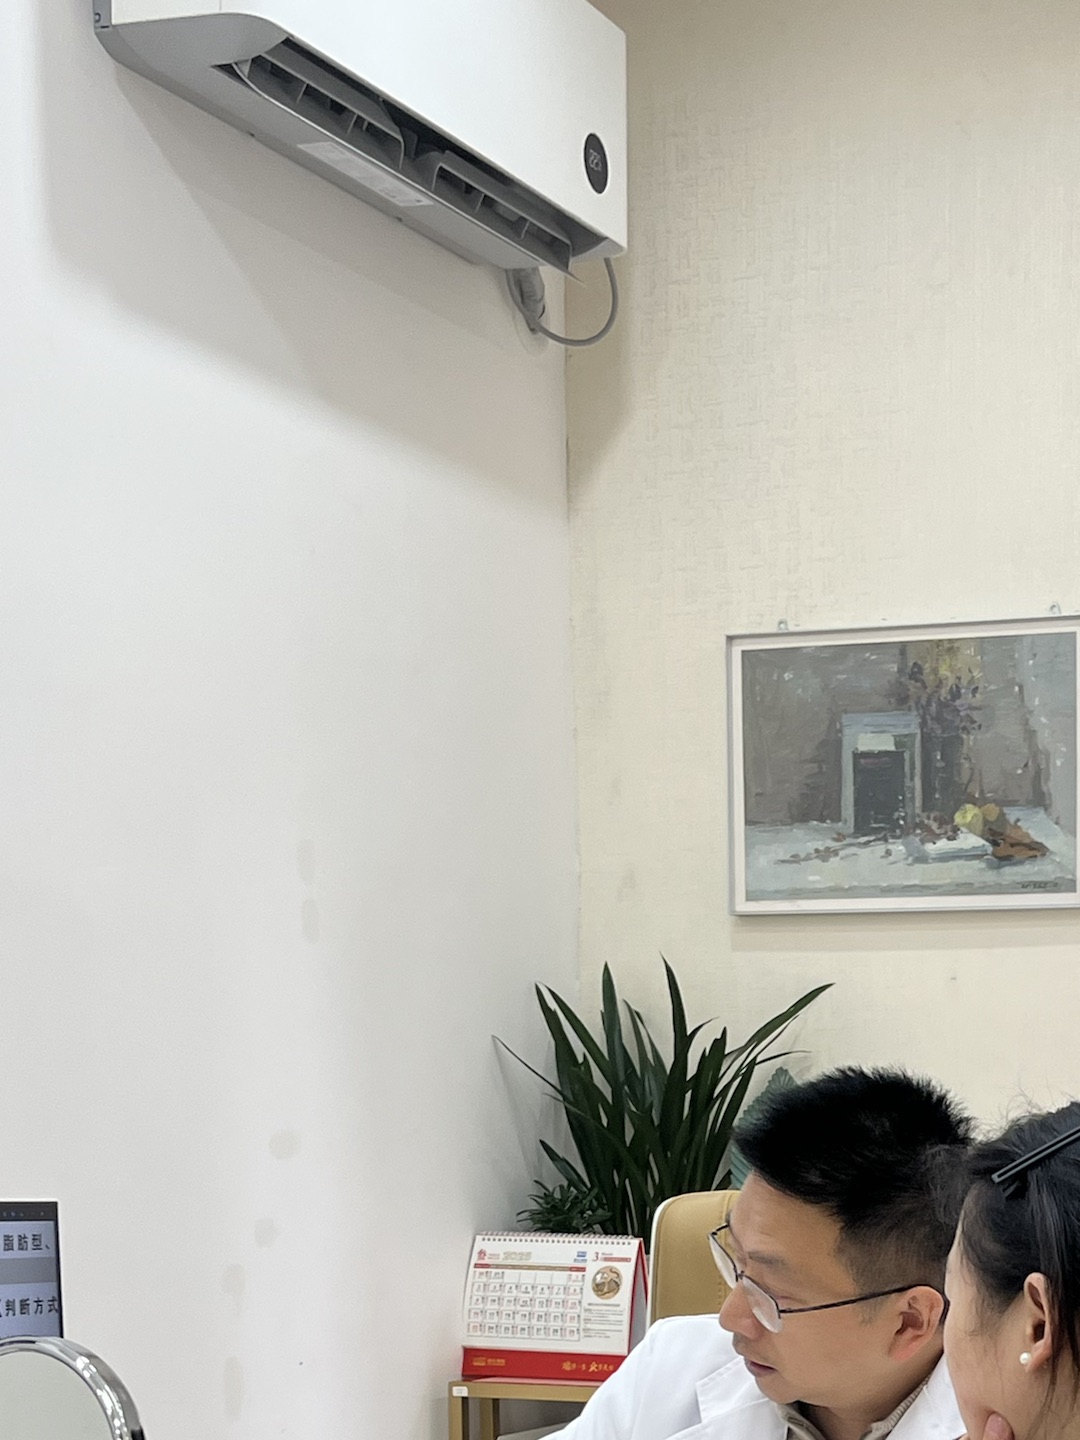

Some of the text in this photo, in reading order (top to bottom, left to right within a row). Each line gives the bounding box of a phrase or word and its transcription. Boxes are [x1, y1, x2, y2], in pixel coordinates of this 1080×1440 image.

[592, 1251, 600, 1263] 3
[0, 1296, 58, 1318] 判断方式
